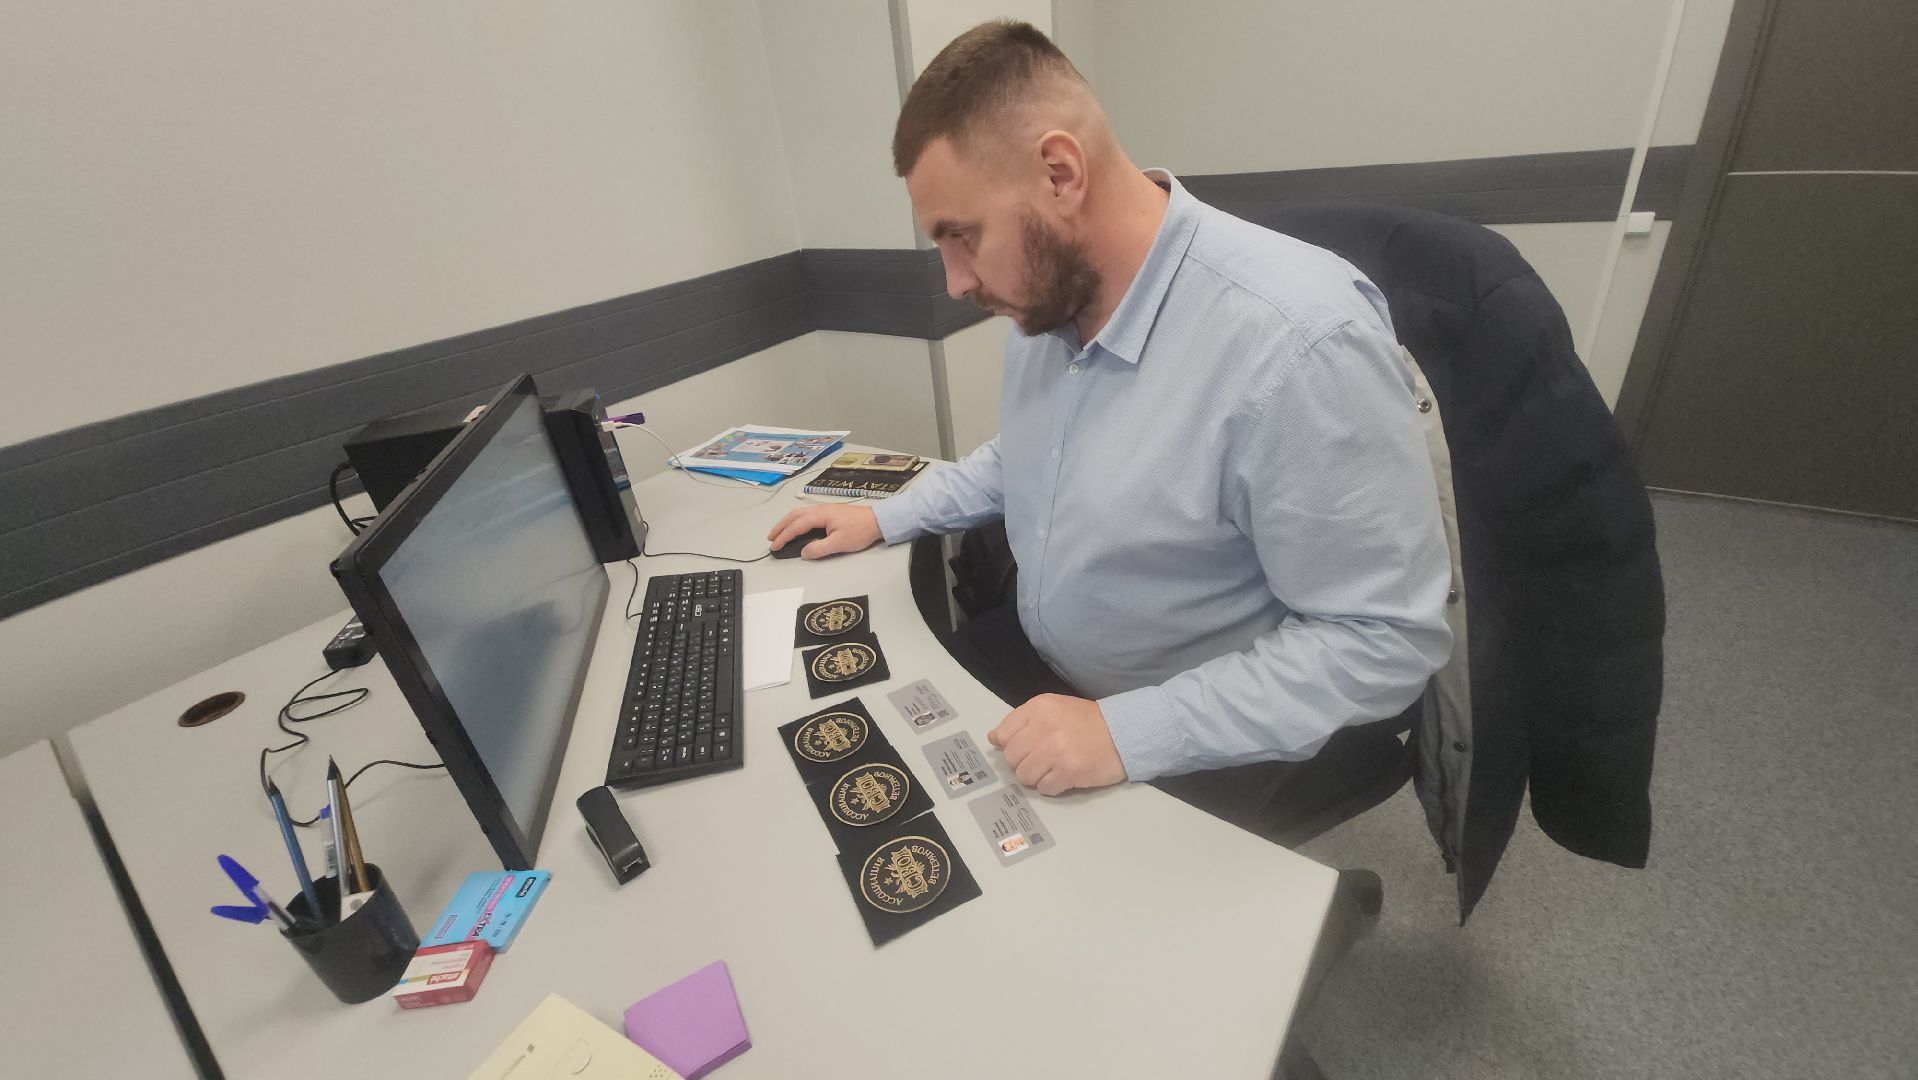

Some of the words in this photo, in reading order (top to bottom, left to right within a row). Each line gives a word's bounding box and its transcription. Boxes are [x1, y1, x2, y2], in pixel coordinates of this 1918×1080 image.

[859, 482, 899, 492] STAY
[838, 782, 869, 820] АССОЦИАЦИЯ
[874, 771, 901, 801] ВЕТЕРАНОВ
[869, 856, 904, 905] АССОЦИАЦИЯ
[896, 855, 923, 890] СВО
[911, 845, 941, 885] ВЕТЕРАНОВ
